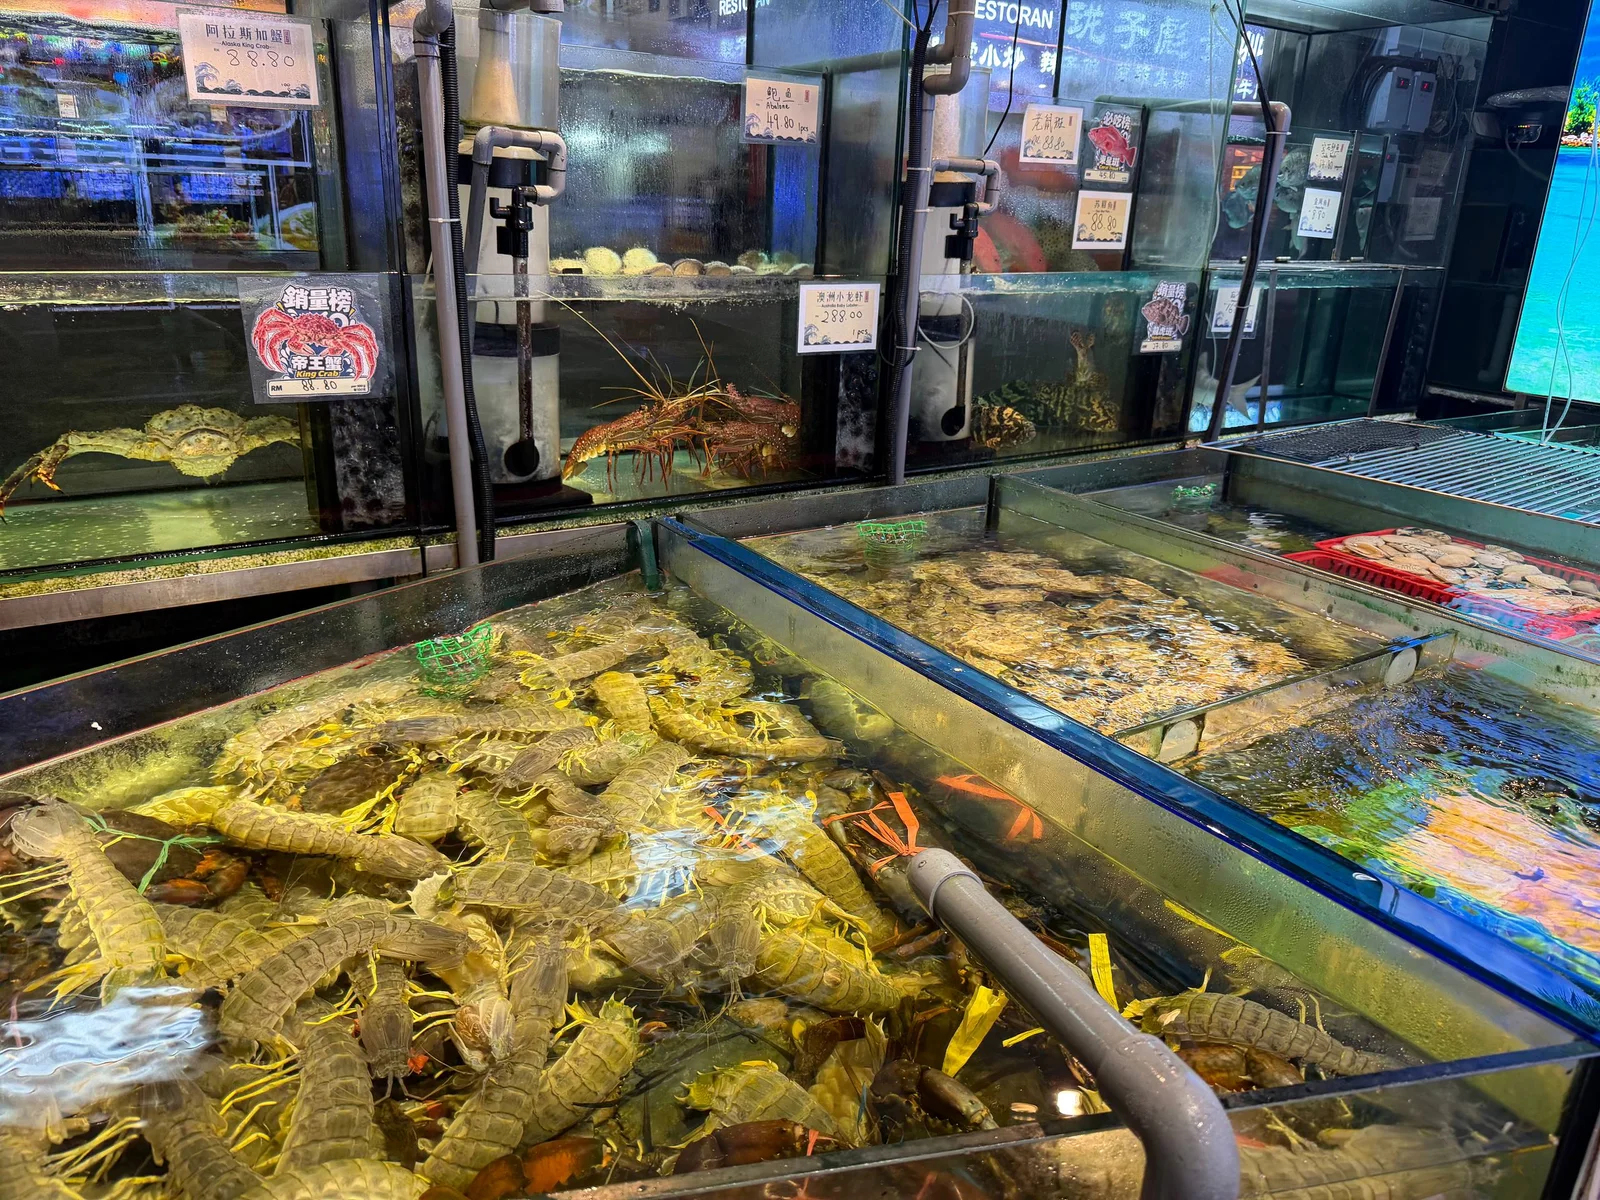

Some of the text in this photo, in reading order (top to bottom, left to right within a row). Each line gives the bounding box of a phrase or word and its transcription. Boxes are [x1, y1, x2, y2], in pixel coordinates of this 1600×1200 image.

[974, 0, 1054, 30] ESTORAN
[205, 23, 283, 43] 阿拉斯加蟹
[226, 49, 295, 67] 88.80
[767, 111, 794, 130] 49.80
[1091, 213, 1116, 231] 88.80
[821, 309, 862, 323] 288.00
